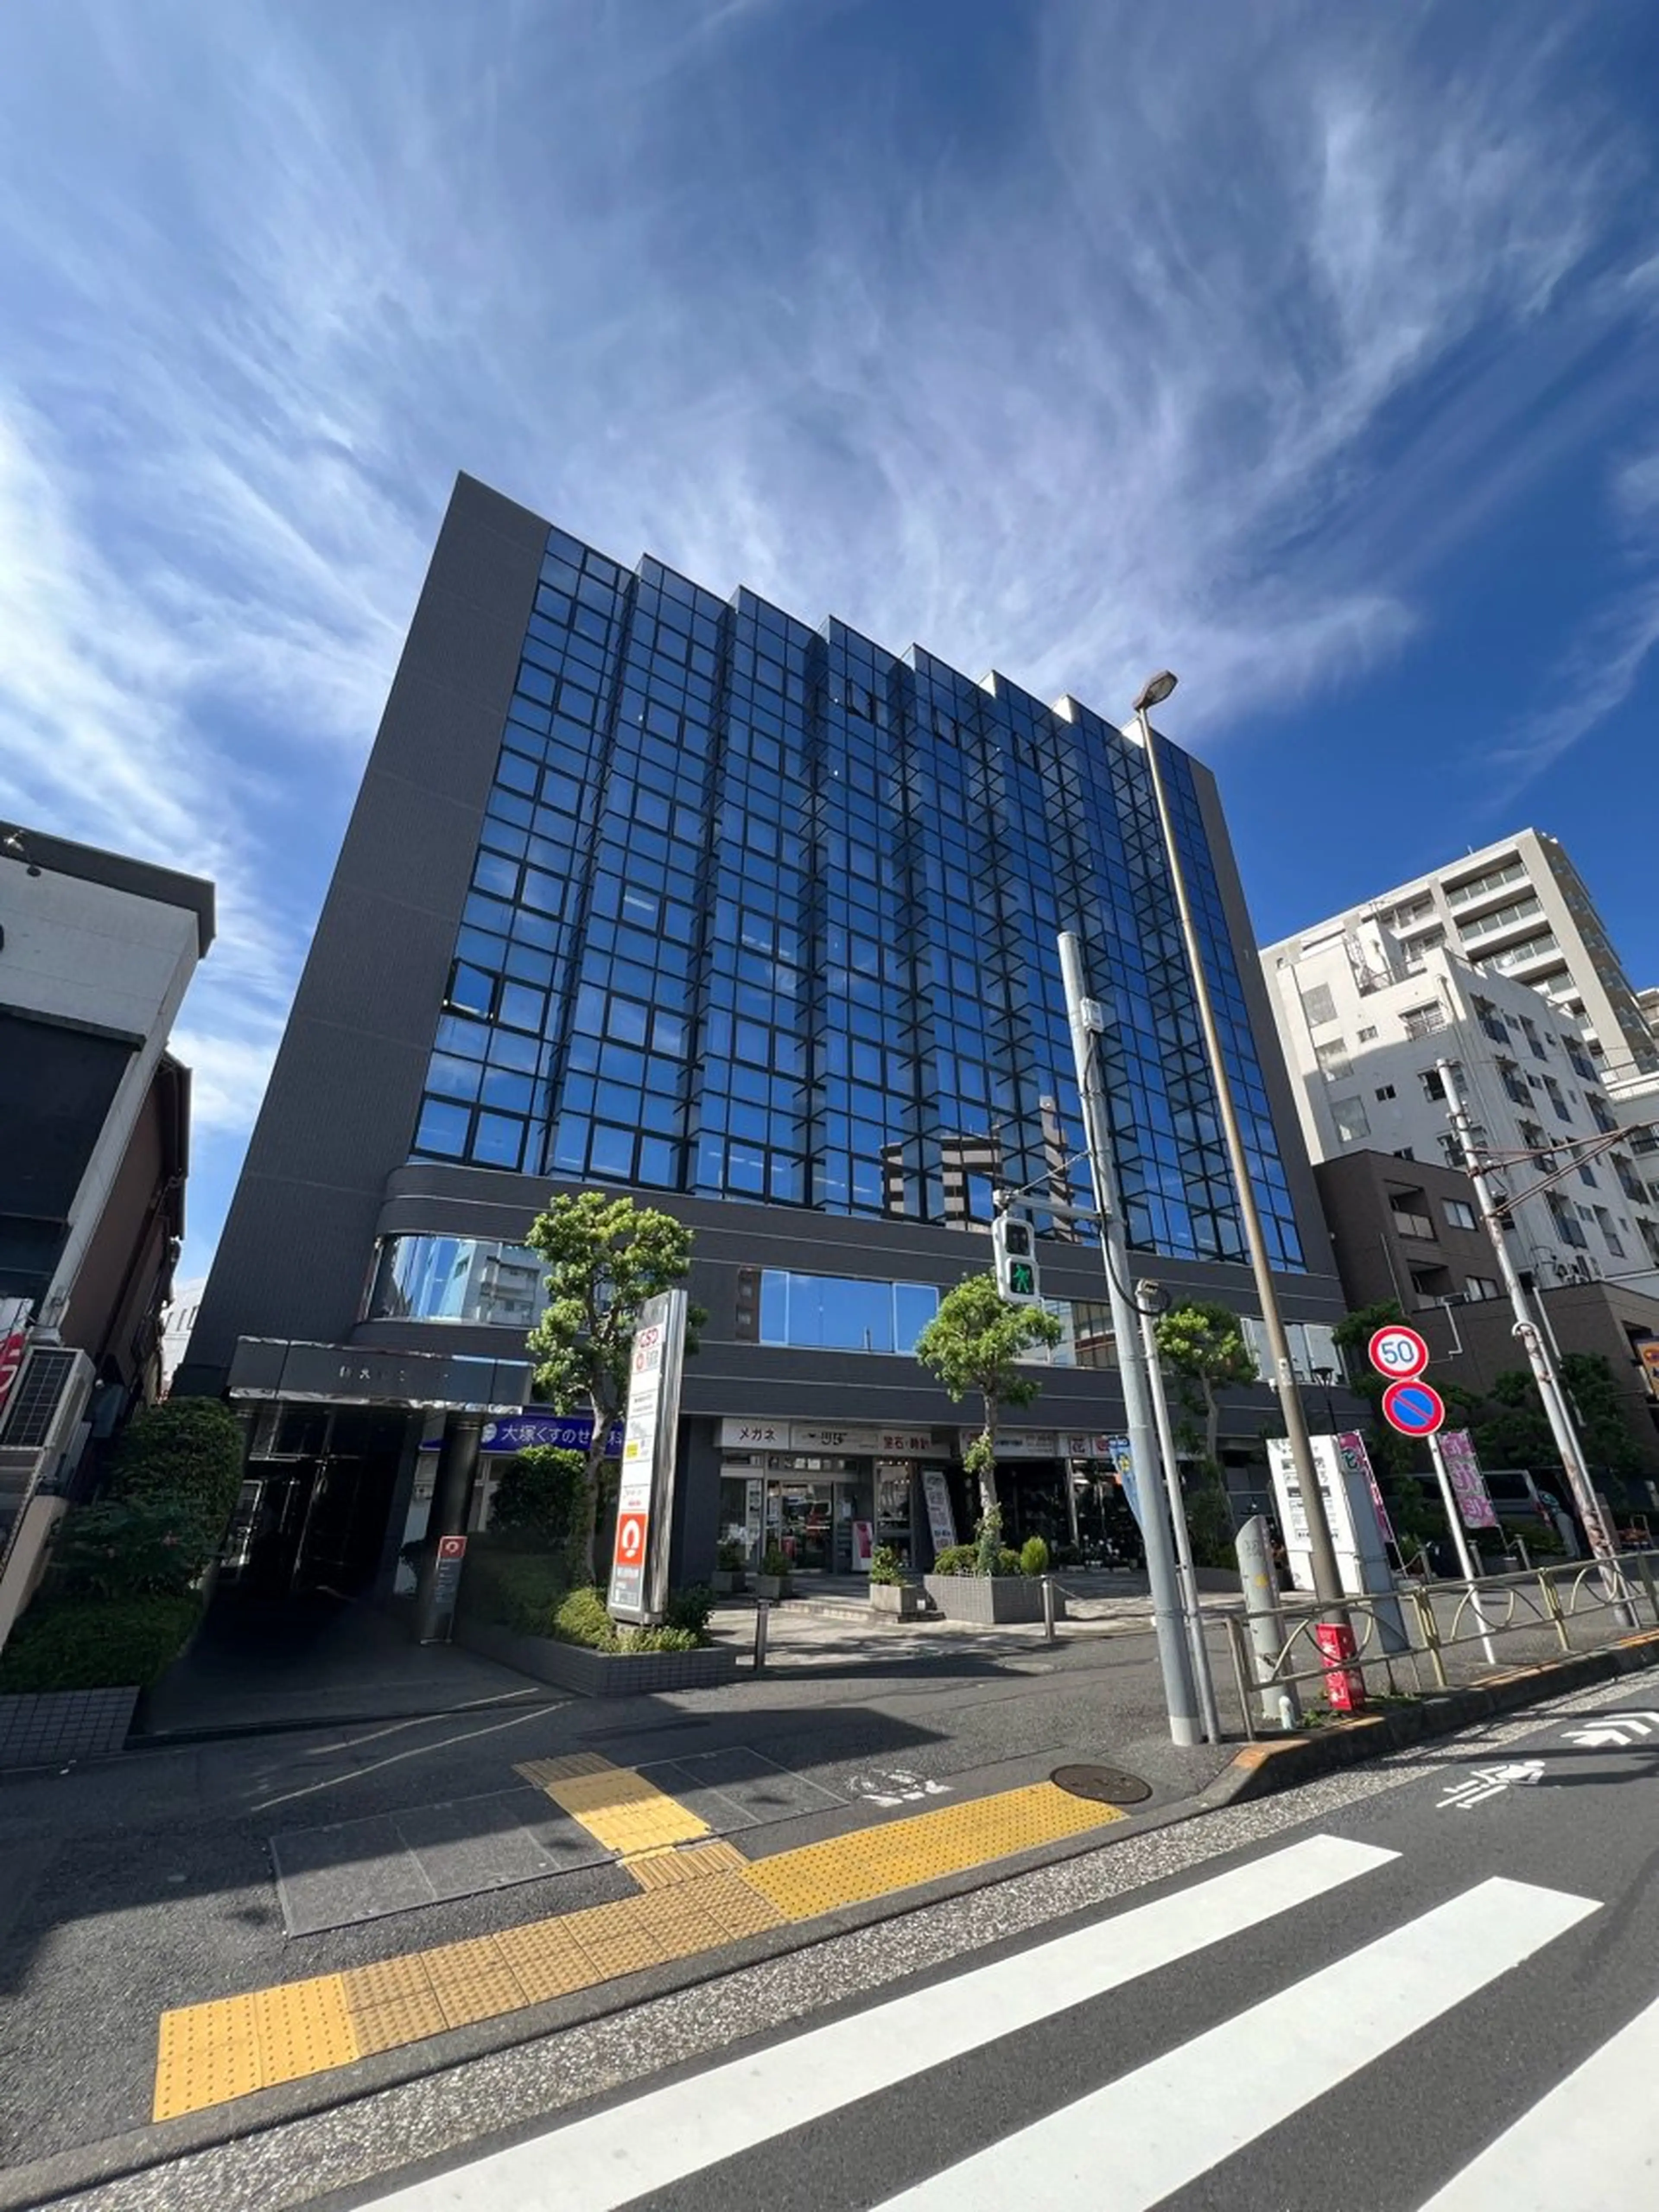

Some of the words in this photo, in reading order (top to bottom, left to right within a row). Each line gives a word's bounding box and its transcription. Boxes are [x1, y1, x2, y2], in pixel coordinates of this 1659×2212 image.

[1382, 1340, 1414, 1364] 50
[500, 1424, 622, 1446] 大塚くすのせ科
[739, 1426, 777, 1442] メガネ
